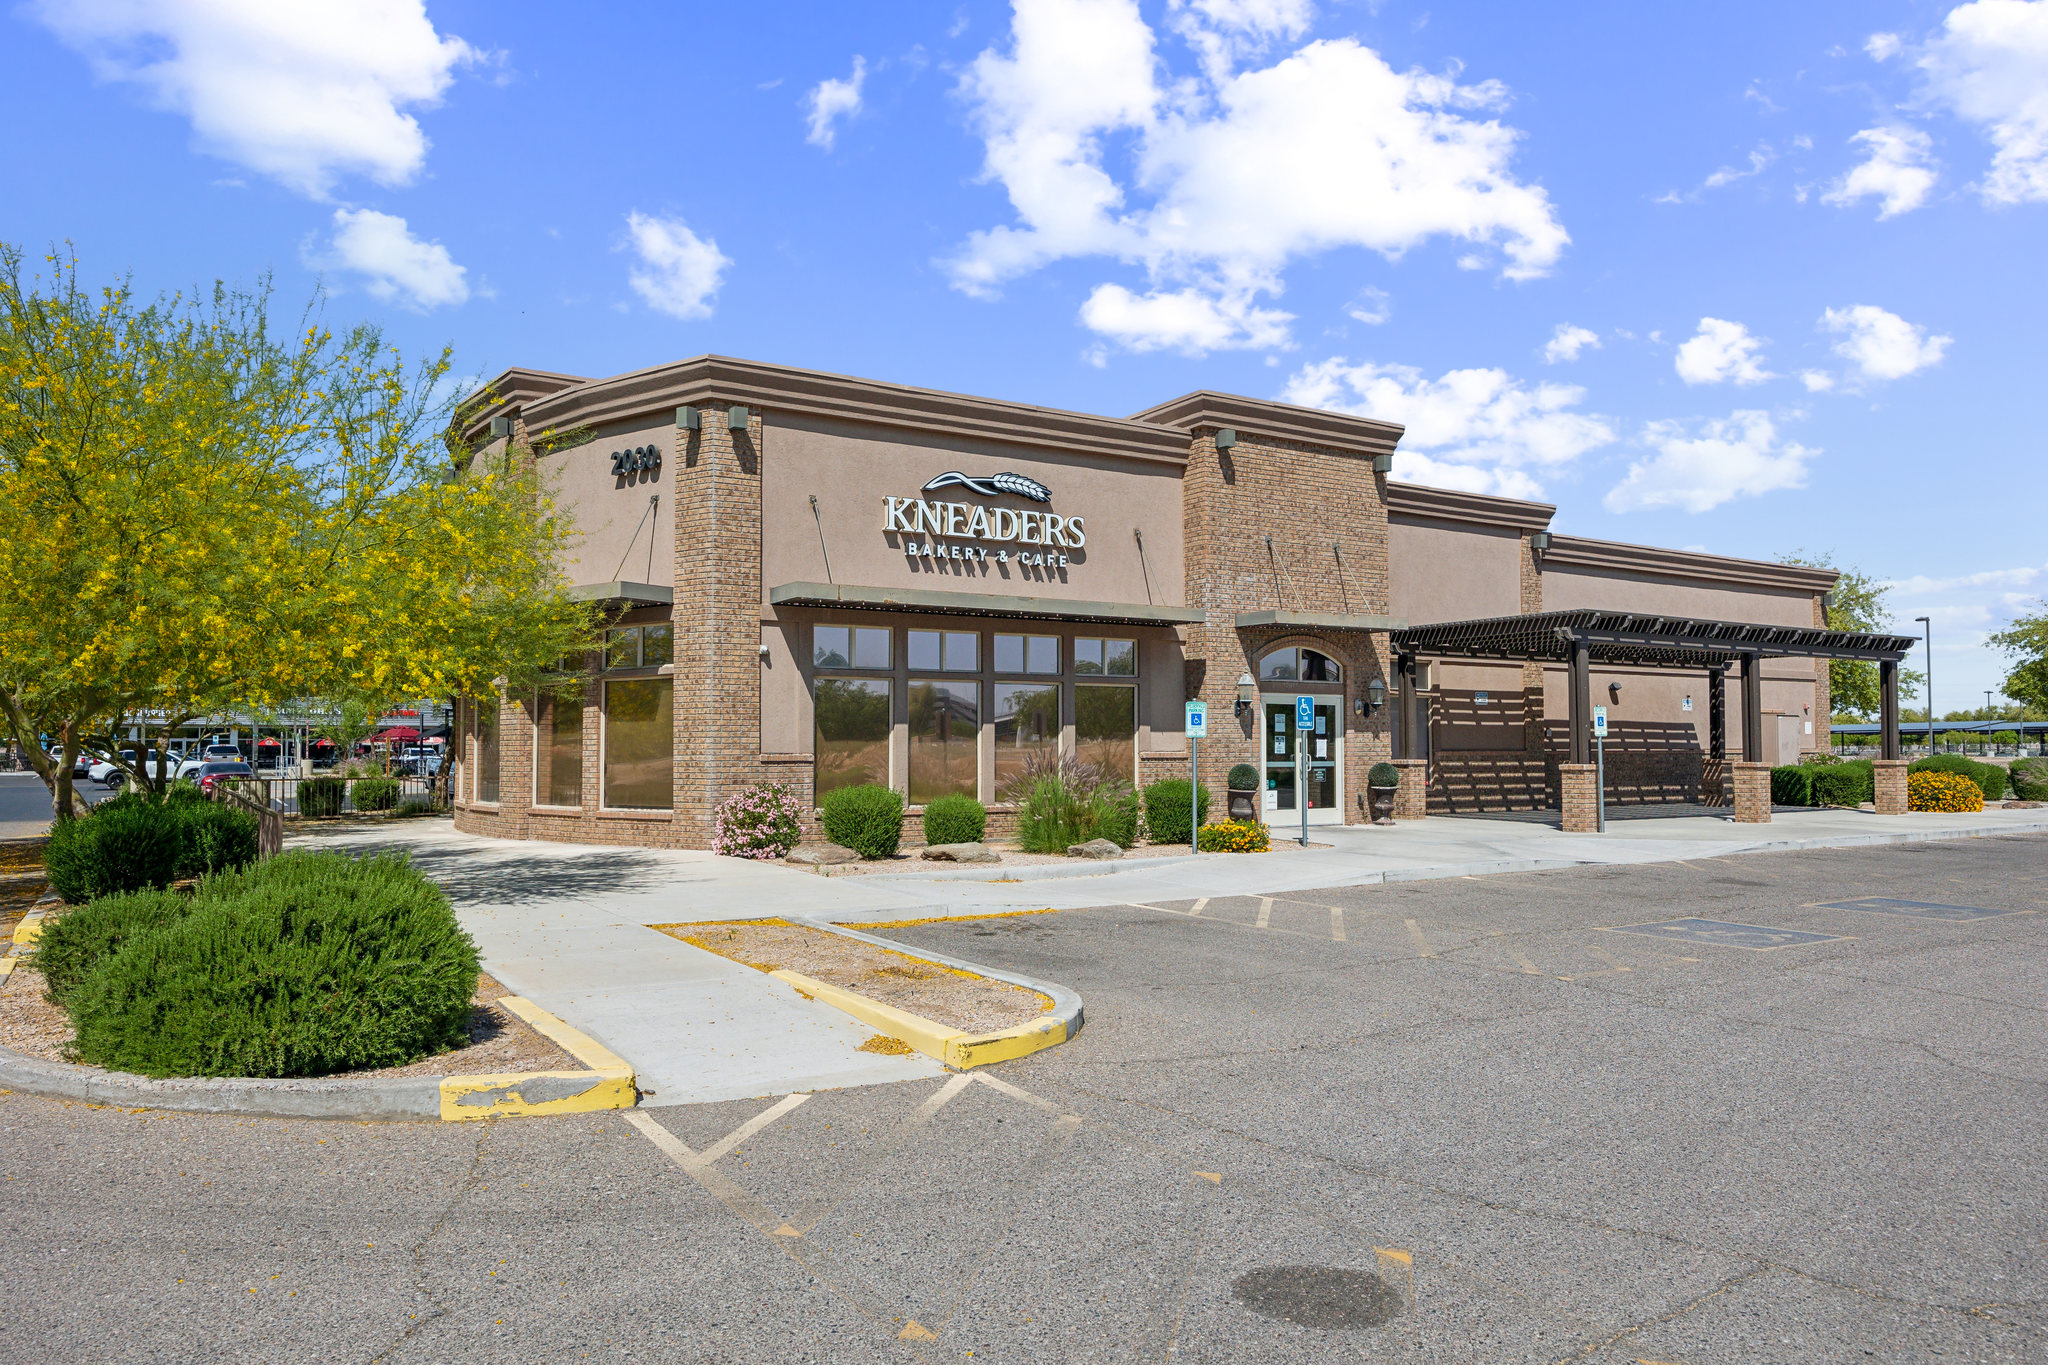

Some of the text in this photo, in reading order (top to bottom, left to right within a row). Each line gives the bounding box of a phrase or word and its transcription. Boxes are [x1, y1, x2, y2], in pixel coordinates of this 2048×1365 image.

[610, 444, 657, 476] 2030
[882, 495, 1087, 549] KNEADERS
[906, 542, 1068, 568] BAKERY & CAFE
